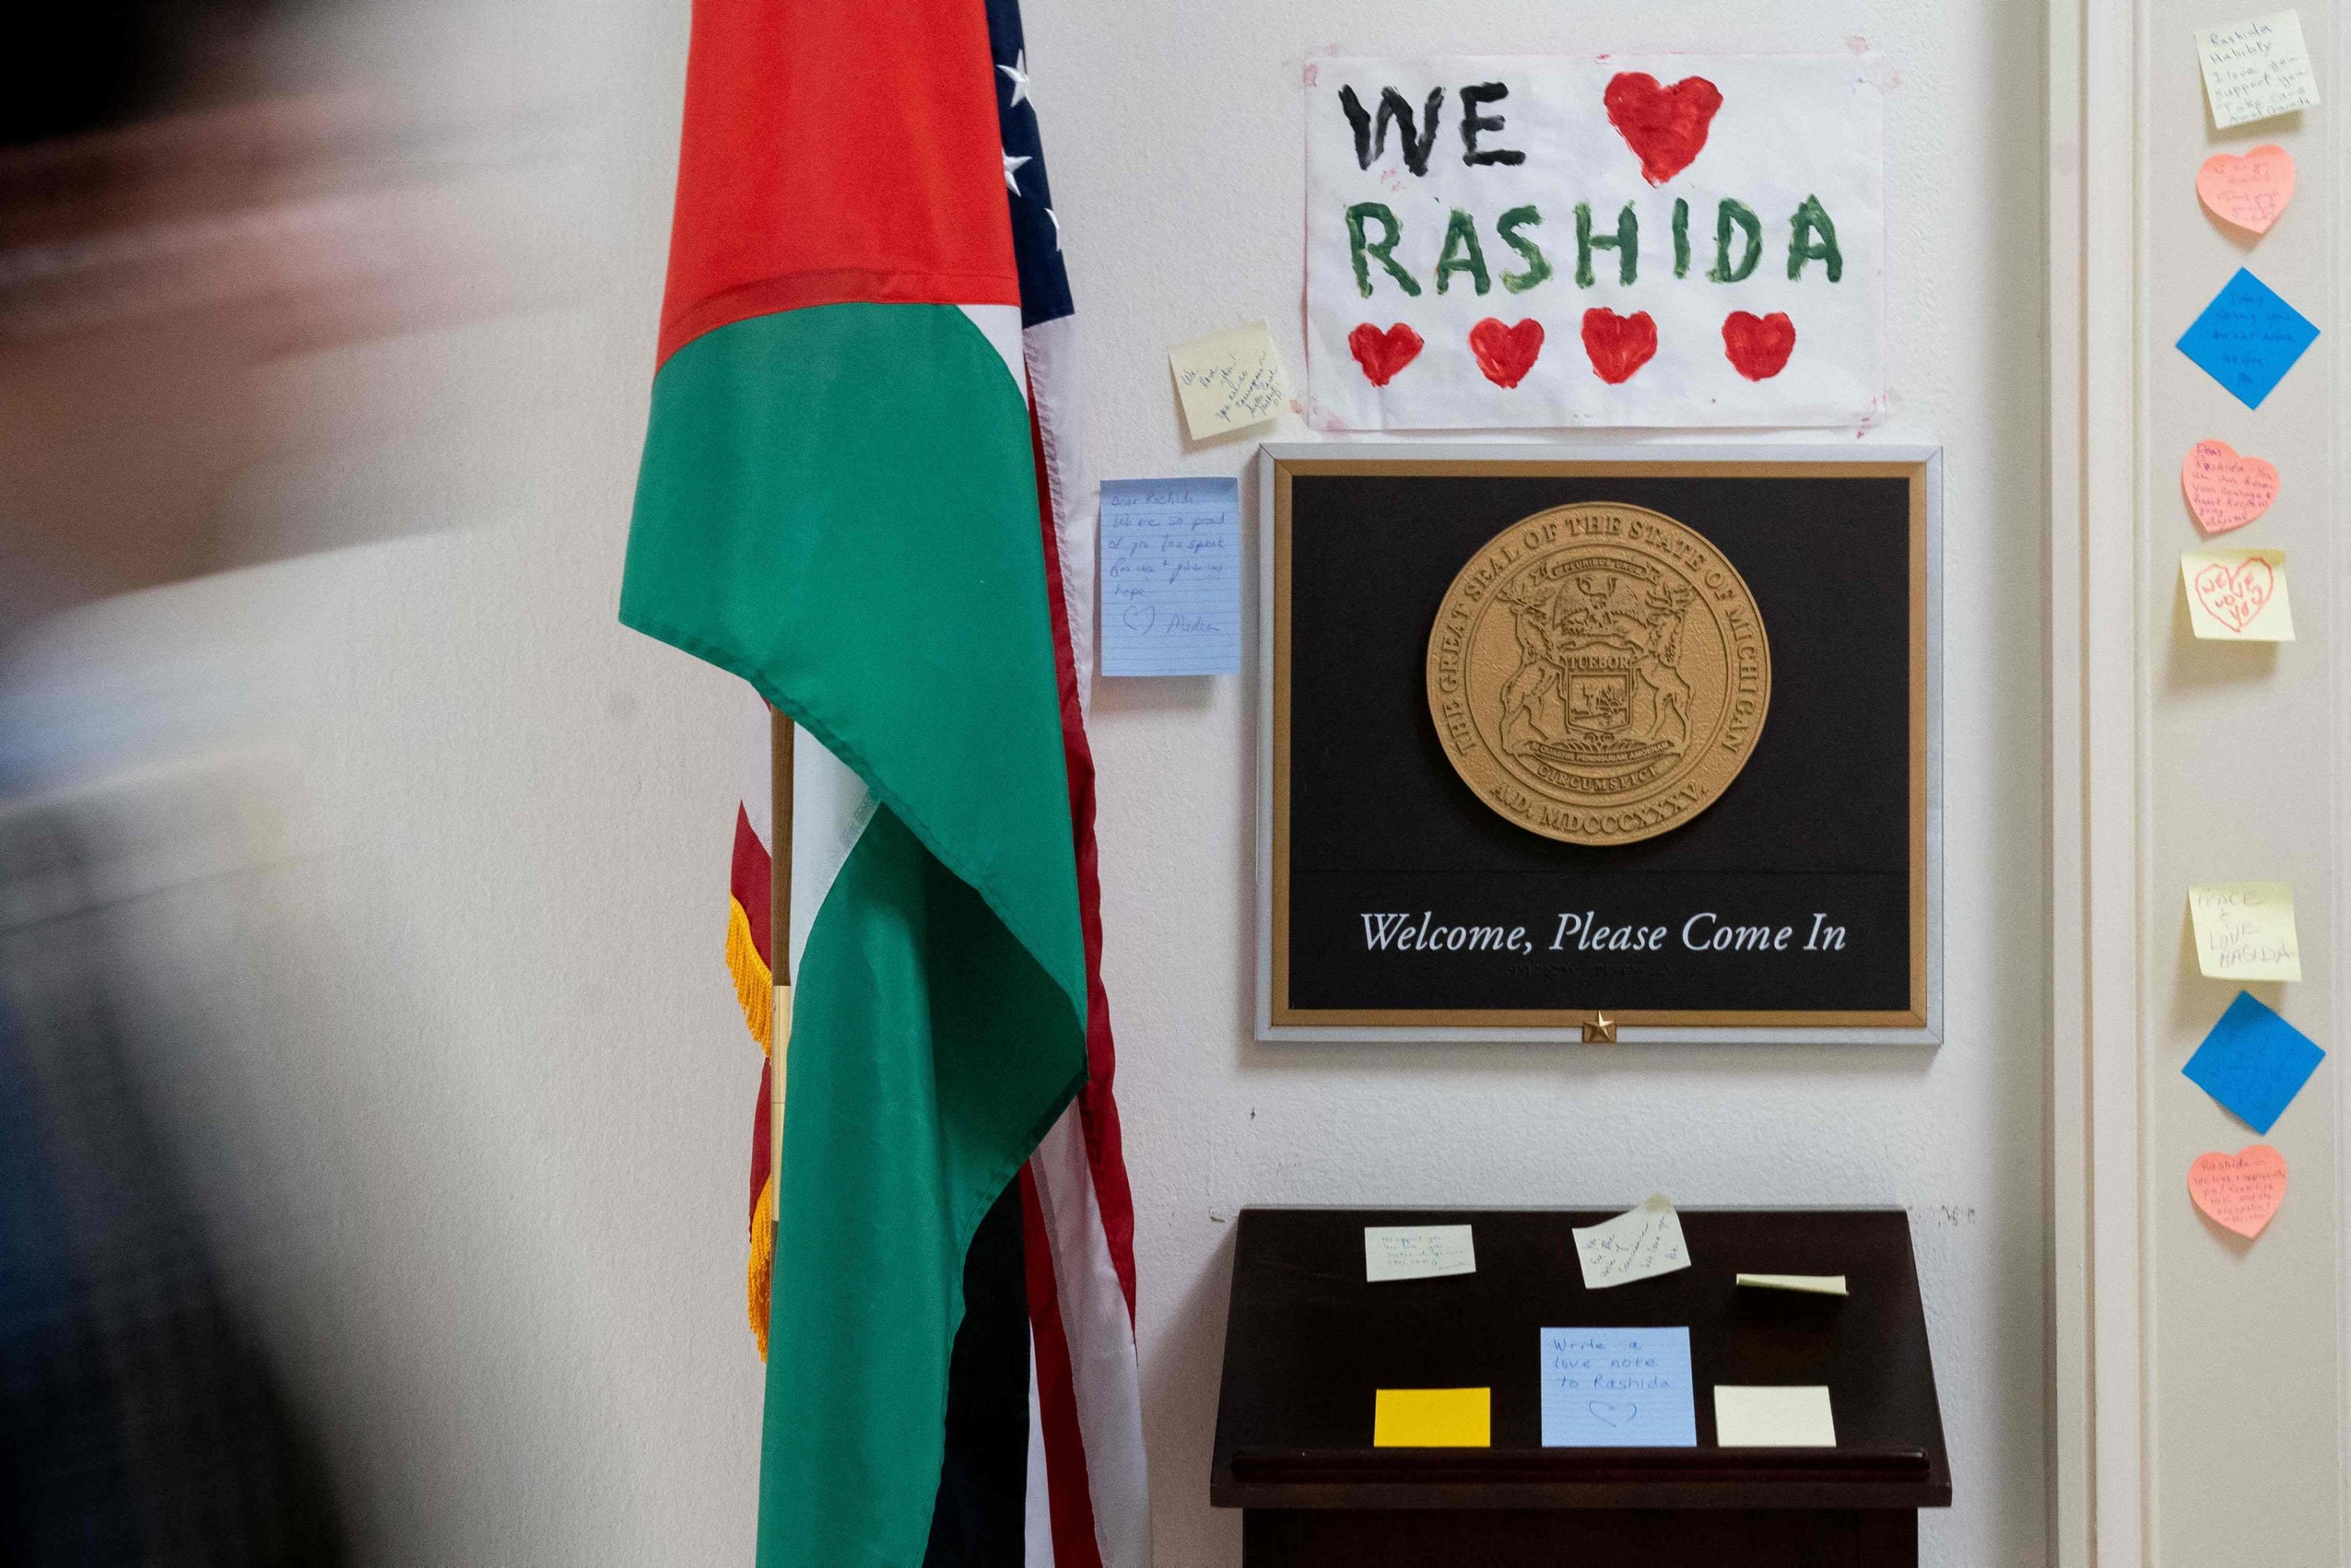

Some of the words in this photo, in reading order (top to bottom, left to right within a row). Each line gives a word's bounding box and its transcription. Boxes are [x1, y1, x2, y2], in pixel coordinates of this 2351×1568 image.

[1338, 81, 1526, 176] WE
[1344, 194, 1842, 299] RASHIDA
[1523, 521, 1561, 552] OF
[1565, 516, 1621, 538] THE
[1628, 517, 1709, 570] STATE
[1469, 543, 1521, 603] SEAL
[1704, 569, 1737, 603] OF
[1439, 603, 1472, 693] GREAT
[1567, 657, 1630, 669] TUEBOR
[1721, 603, 1758, 755] MICHIGAN
[1446, 696, 1474, 755] THE
[1360, 911, 1533, 954] Welcome,
[1550, 911, 1667, 951] Please
[1683, 912, 1789, 951] Come
[1803, 912, 1846, 951] In
[1553, 1338, 1606, 1352] Write
[1629, 1341, 1642, 1350] a
[1555, 1357, 1593, 1369] love
[1610, 1357, 1657, 1368] note
[1559, 1375, 1578, 1388] to
[1594, 1375, 1669, 1390] Rashida
